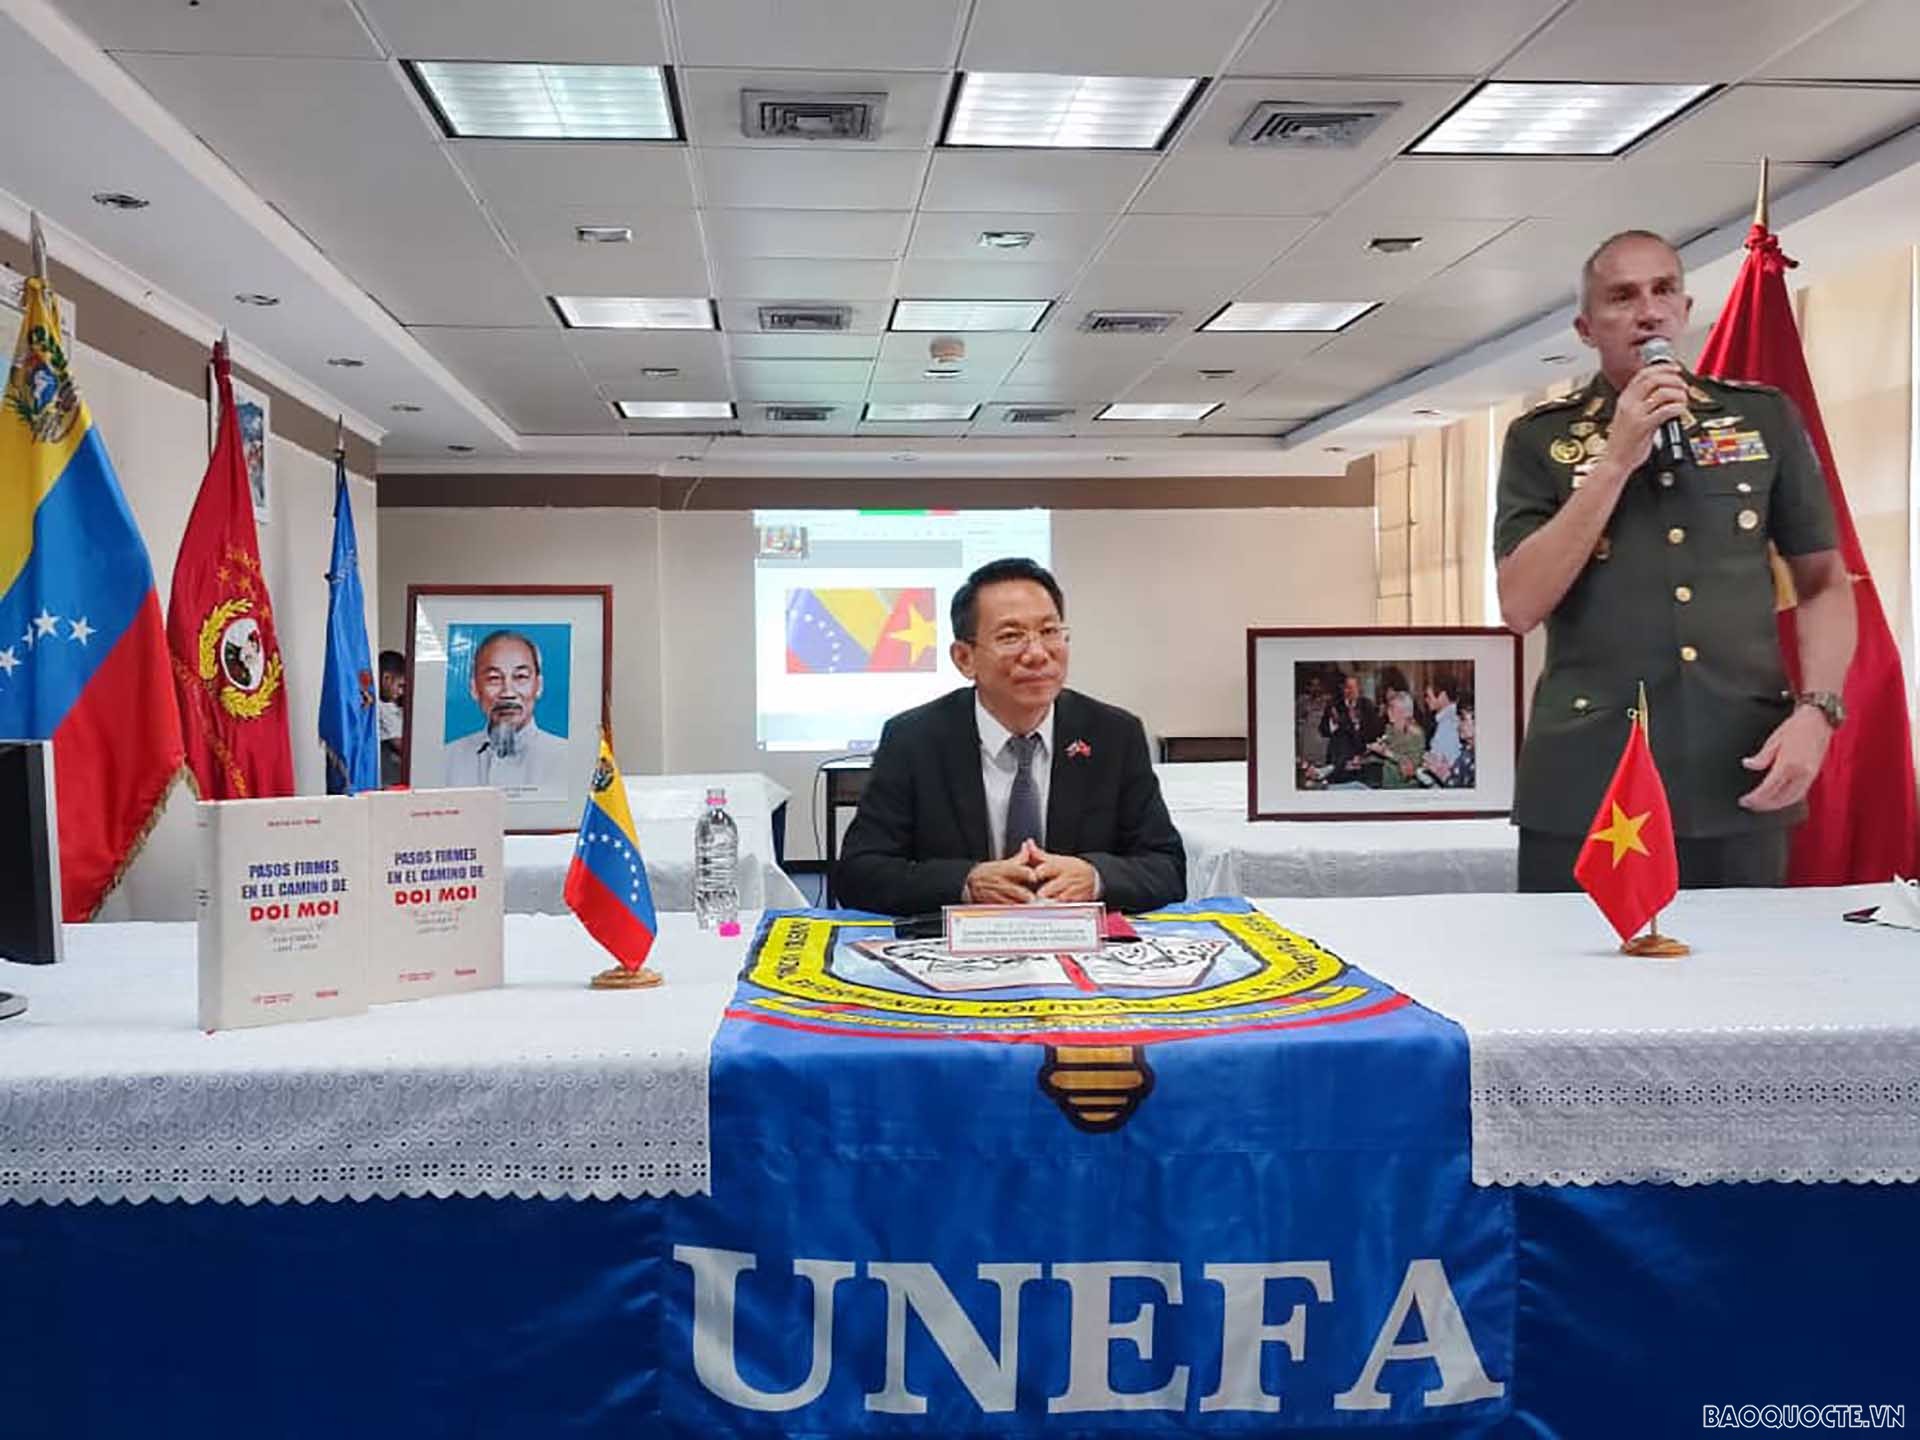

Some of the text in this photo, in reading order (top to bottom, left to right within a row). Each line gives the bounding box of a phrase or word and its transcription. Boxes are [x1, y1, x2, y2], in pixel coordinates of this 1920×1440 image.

[395, 848, 477, 866] PASOS FIRMES
[249, 860, 339, 878] PASOS FIRMES
[388, 865, 484, 884] EN EL CAMINO DE
[241, 878, 347, 899] EN EL CAMINO DE
[395, 885, 477, 905] DOI MOI
[250, 900, 339, 921] DOI MOI
[673, 1244, 1505, 1414] UNEFA
